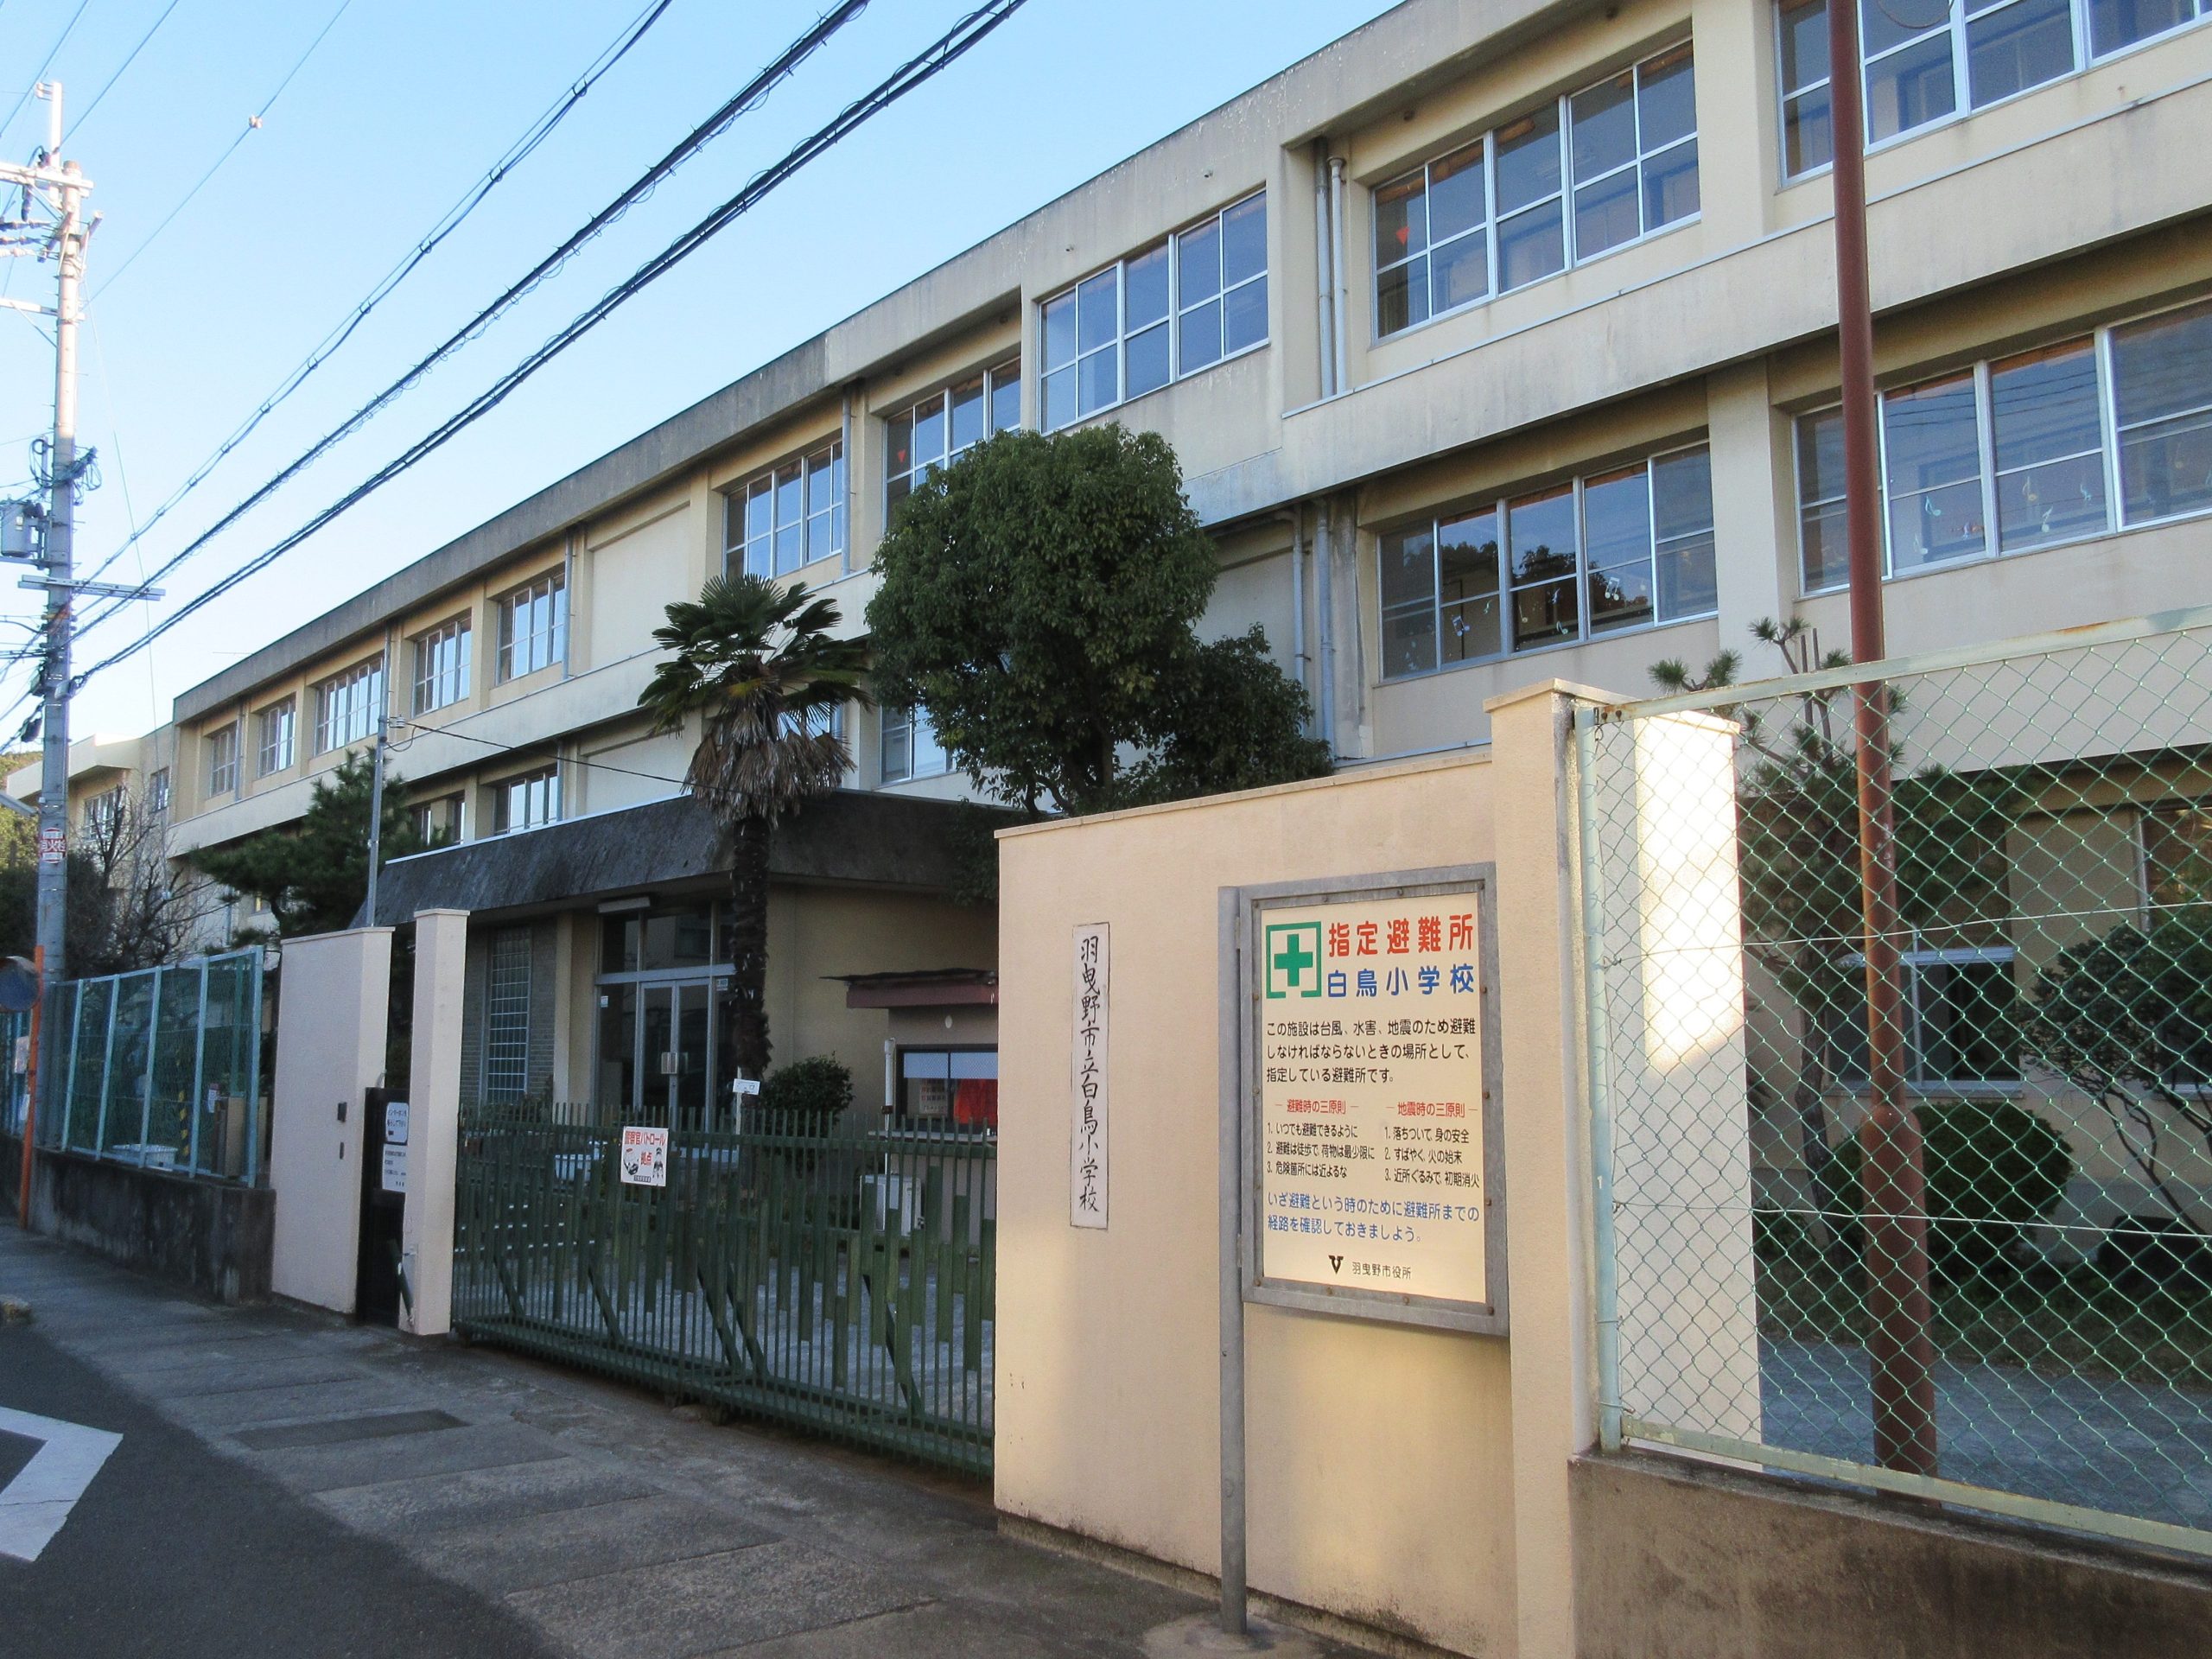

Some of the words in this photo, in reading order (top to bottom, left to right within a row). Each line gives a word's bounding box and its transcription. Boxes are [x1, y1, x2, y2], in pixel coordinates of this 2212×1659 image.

[1329, 913, 1473, 957] 指定避難所
[1327, 963, 1474, 998] 白鳥小学校
[1267, 1018, 1476, 1037] この施設は台風、水害、地震のため避難
[1267, 1044, 1470, 1059] しなければならないときの場所として、
[1079, 936, 1100, 1212] 羽曳野市立白鳥小学校
[1267, 1067, 1394, 1084] 指定している避難所です。
[1287, 1099, 1346, 1115] 避難時の三原則
[1397, 1101, 1465, 1118] 地震時の三原則
[1275, 1122, 1358, 1138] いつでも避難できるように
[1268, 1192, 1479, 1222] いざ避難という時のために避難所までの
[1352, 1262, 1412, 1280] 羽曳野市役所
